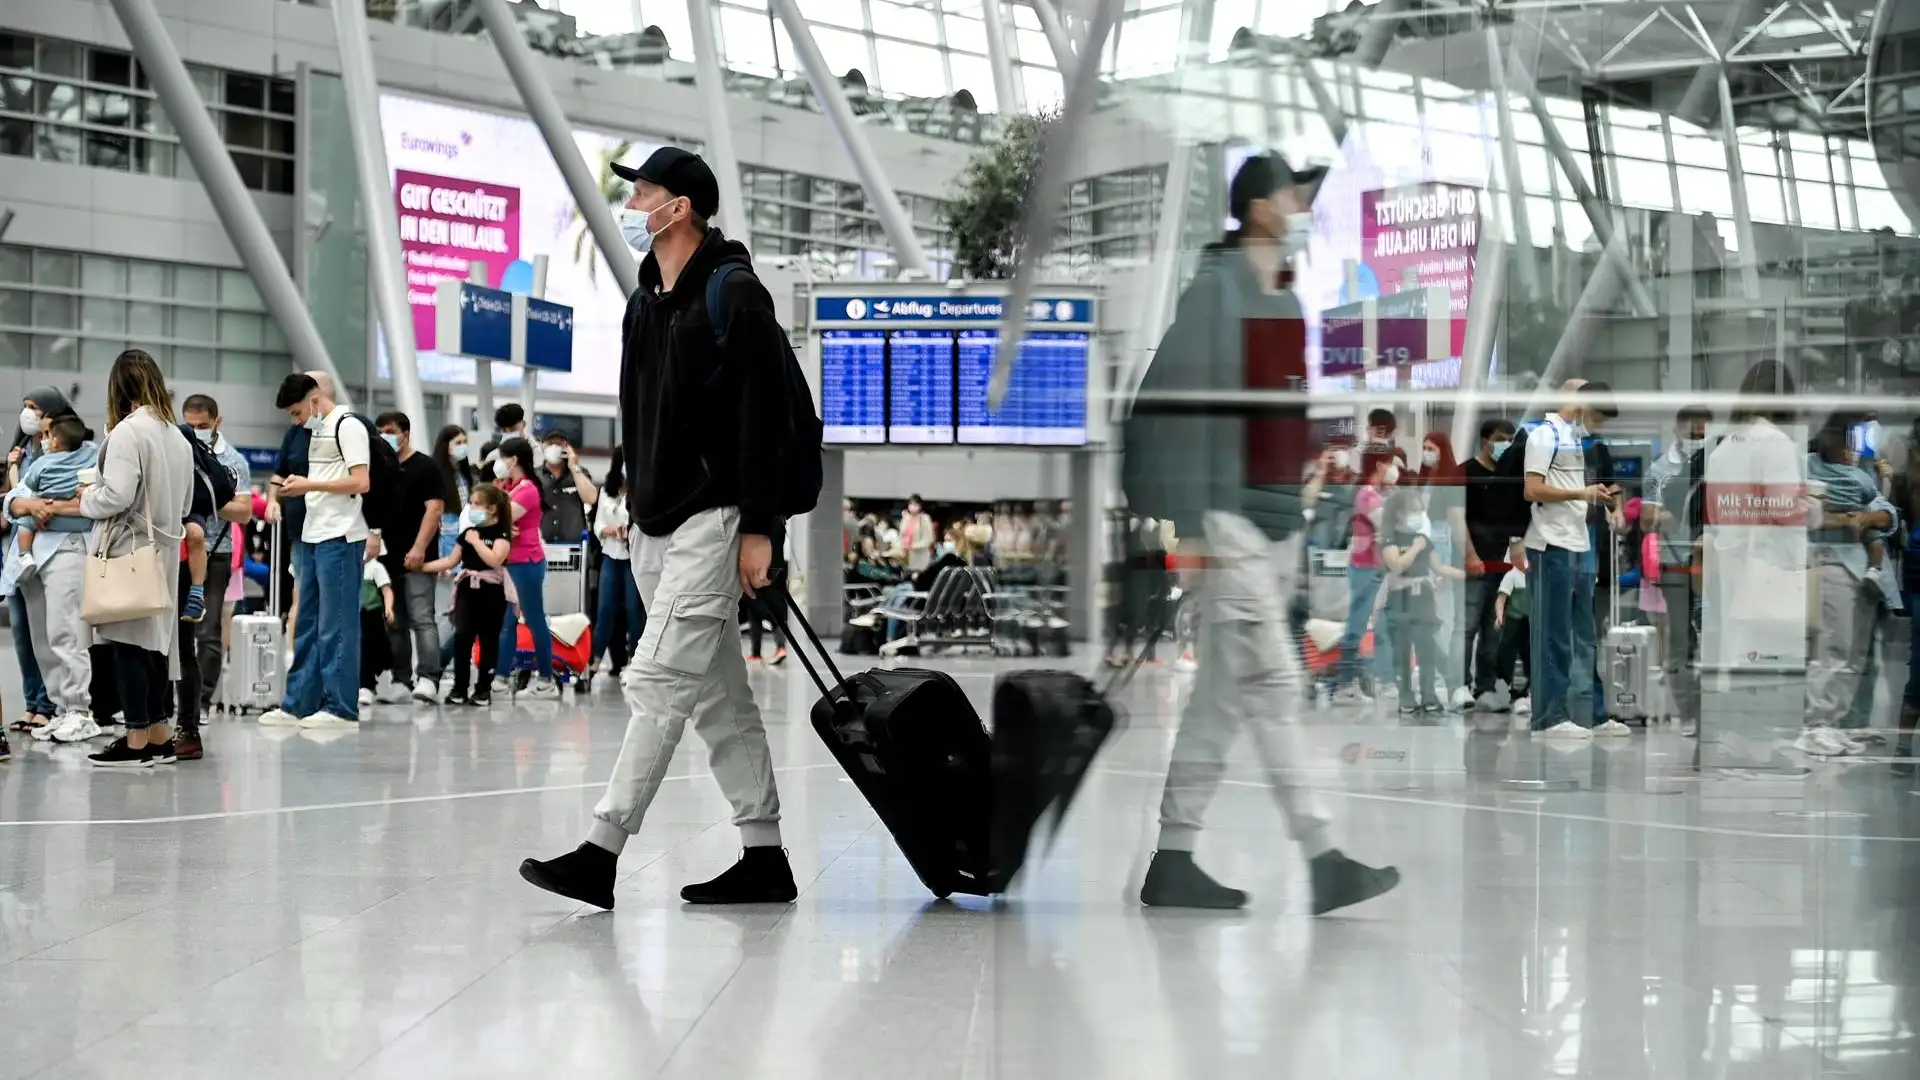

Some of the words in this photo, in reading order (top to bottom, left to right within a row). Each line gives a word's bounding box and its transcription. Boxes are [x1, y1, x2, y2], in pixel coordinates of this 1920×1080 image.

[401, 131, 459, 158] Eurowings
[401, 183, 430, 211] GUT
[431, 187, 508, 222] GESCHÜTZT
[401, 214, 418, 241] IN
[419, 219, 449, 246] DEN
[891, 302, 934, 318] Abflug
[939, 302, 1003, 317] Departures
[1717, 493, 1742, 508] Mit
[1745, 493, 1795, 509] Termin
